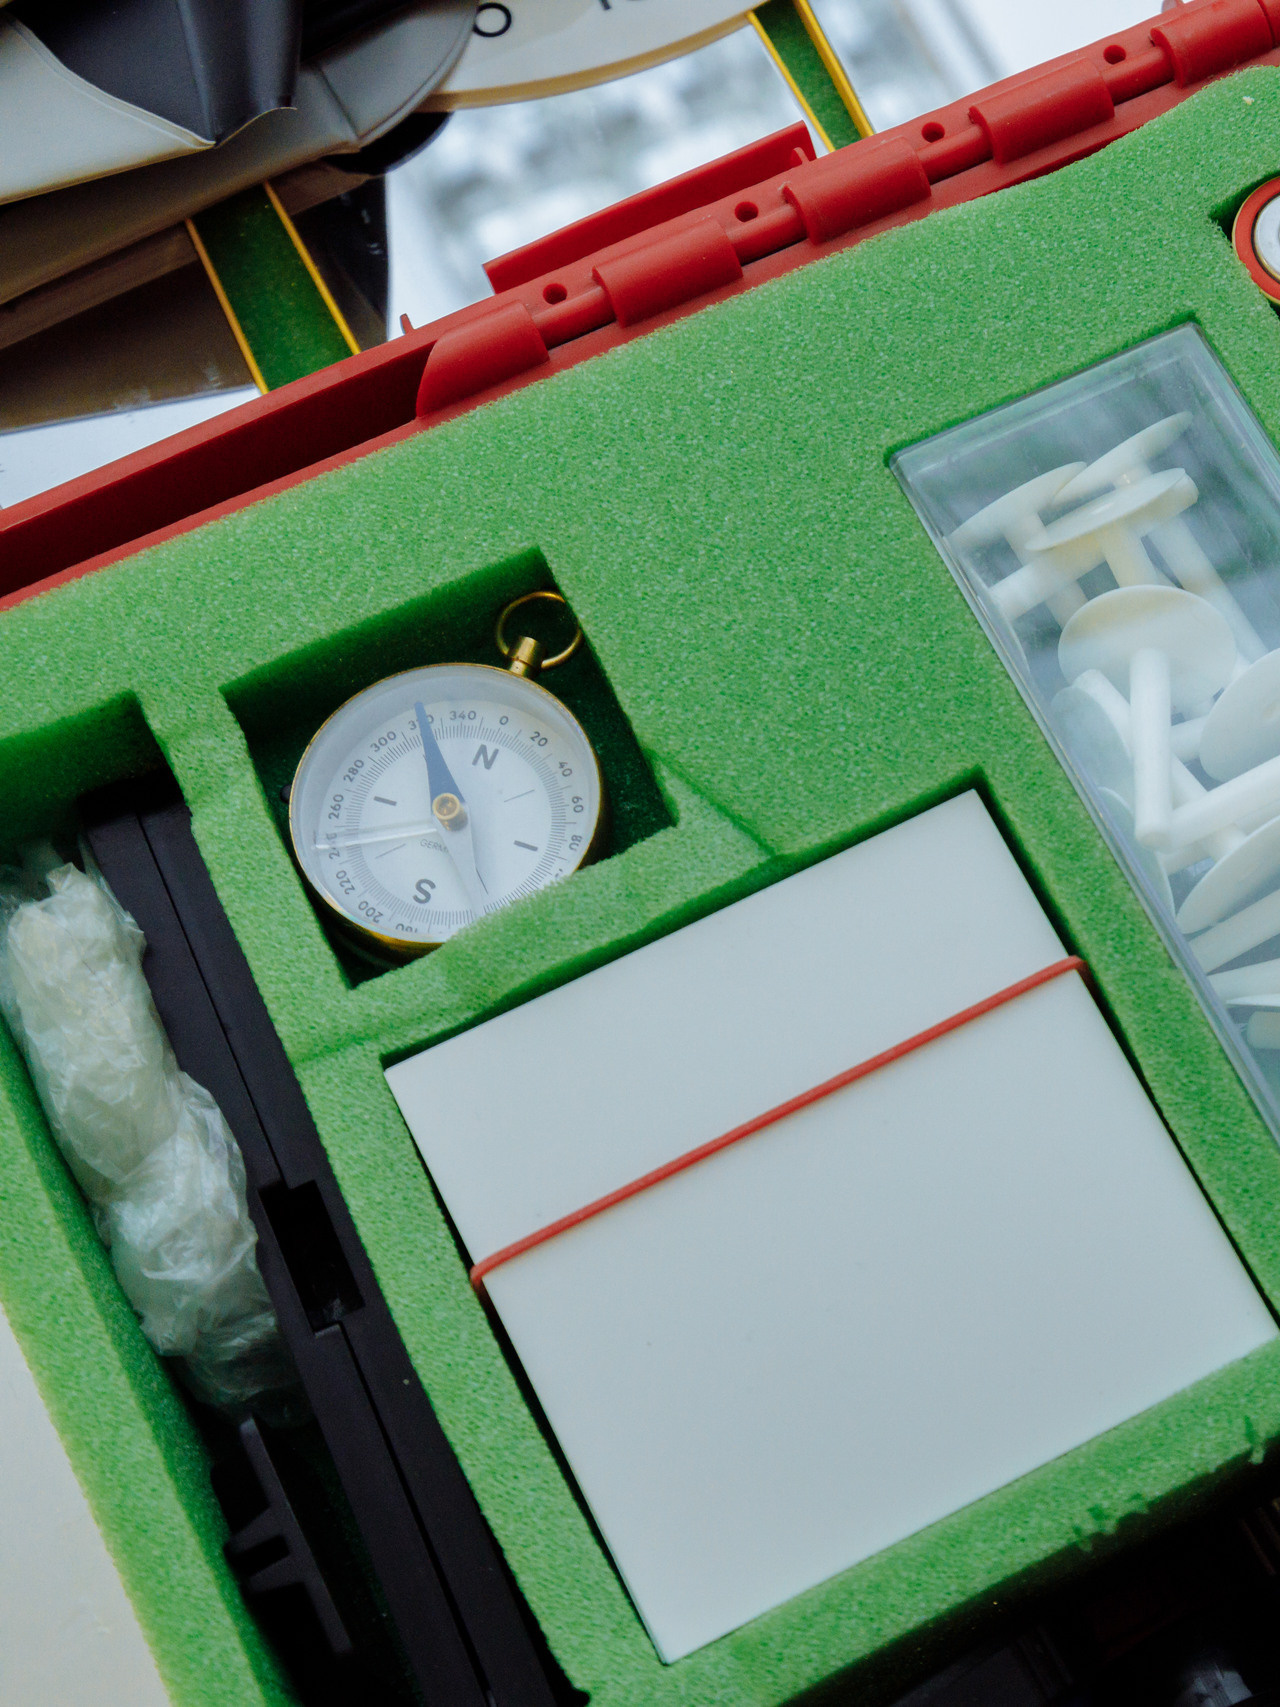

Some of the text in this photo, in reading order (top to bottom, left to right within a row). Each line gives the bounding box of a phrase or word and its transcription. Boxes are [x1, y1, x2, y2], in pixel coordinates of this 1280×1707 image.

[408, 714, 434, 730] 30
[450, 710, 476, 721] 340
[500, 716, 509, 726] 0
[370, 731, 397, 753] 300
[530, 731, 548, 747] 20
[472, 744, 499, 769] N
[344, 759, 364, 782] 280
[558, 760, 573, 777] 40
[329, 794, 344, 820] 260
[571, 796, 584, 814] 60
[336, 870, 355, 895] 220
[413, 878, 436, 904] S
[358, 900, 383, 923] 200
